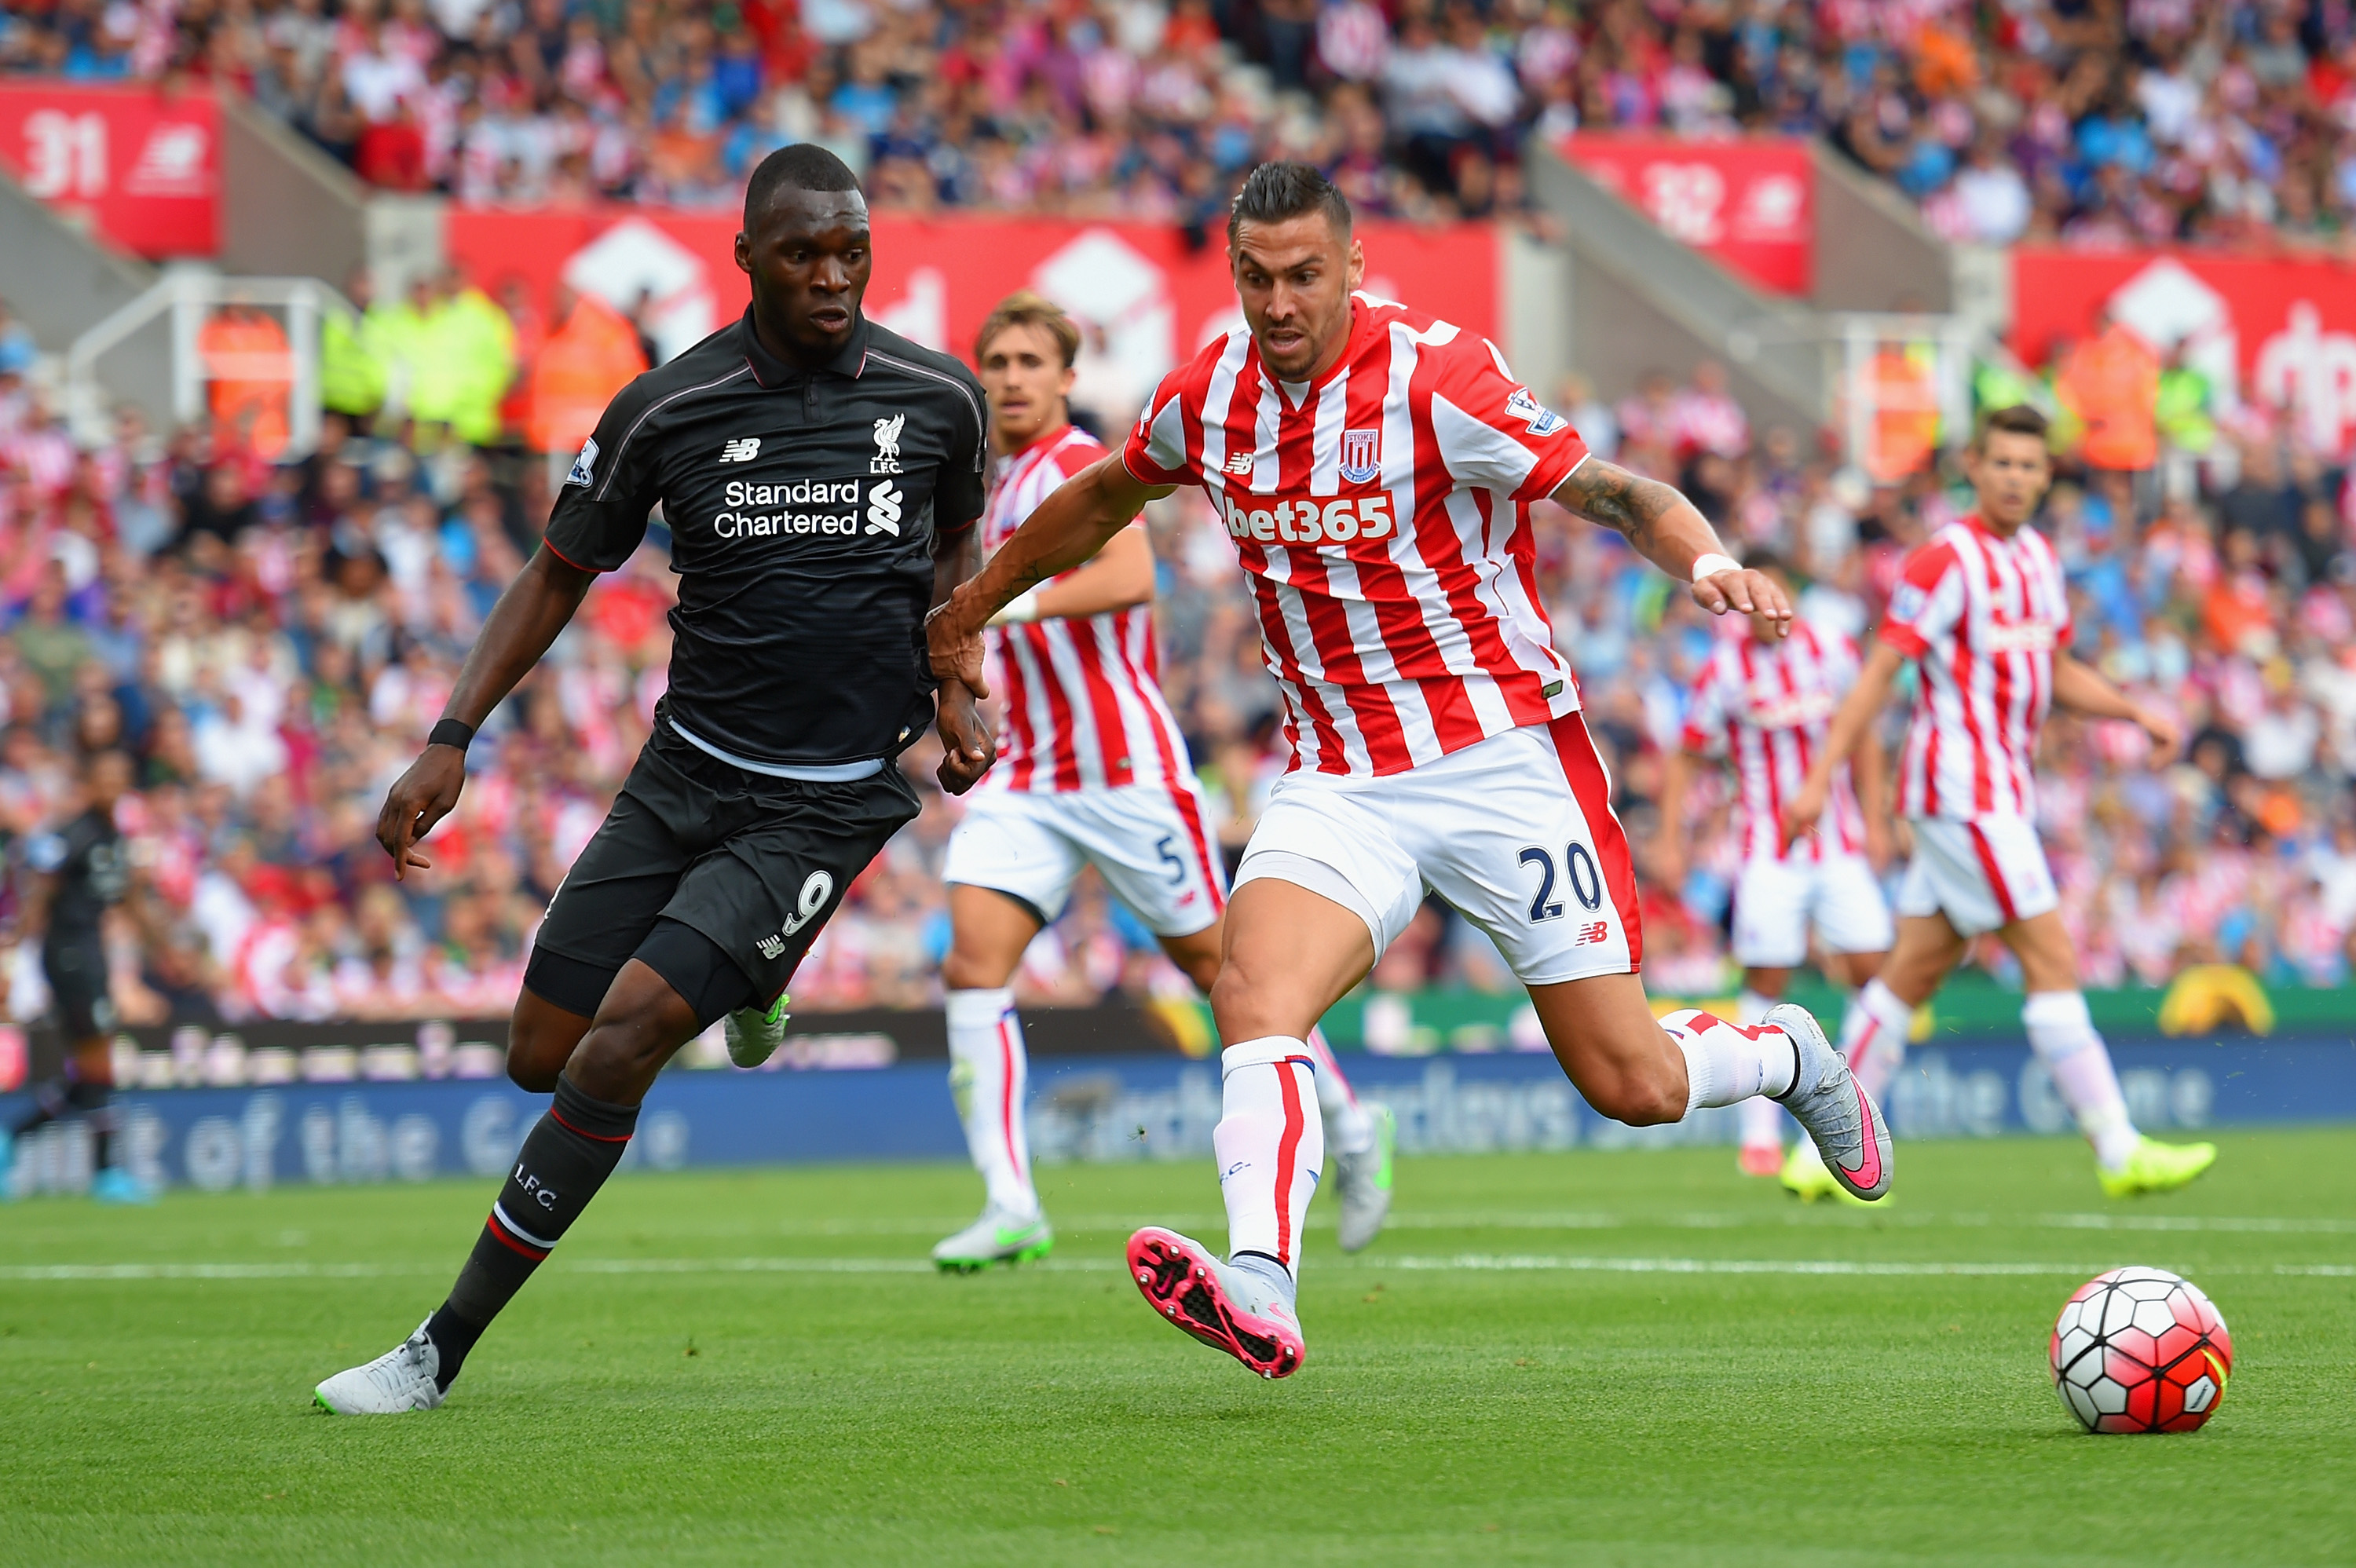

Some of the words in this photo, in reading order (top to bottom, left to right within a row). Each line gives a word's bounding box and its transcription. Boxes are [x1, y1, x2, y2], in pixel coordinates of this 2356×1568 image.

[21, 106, 110, 199] 31
[724, 478, 859, 507] Standard
[713, 510, 858, 539] Chartered
[1225, 495, 1392, 543] bet365
[1155, 836, 1186, 886] 5
[1516, 839, 1603, 924] 20
[781, 869, 833, 937] 9
